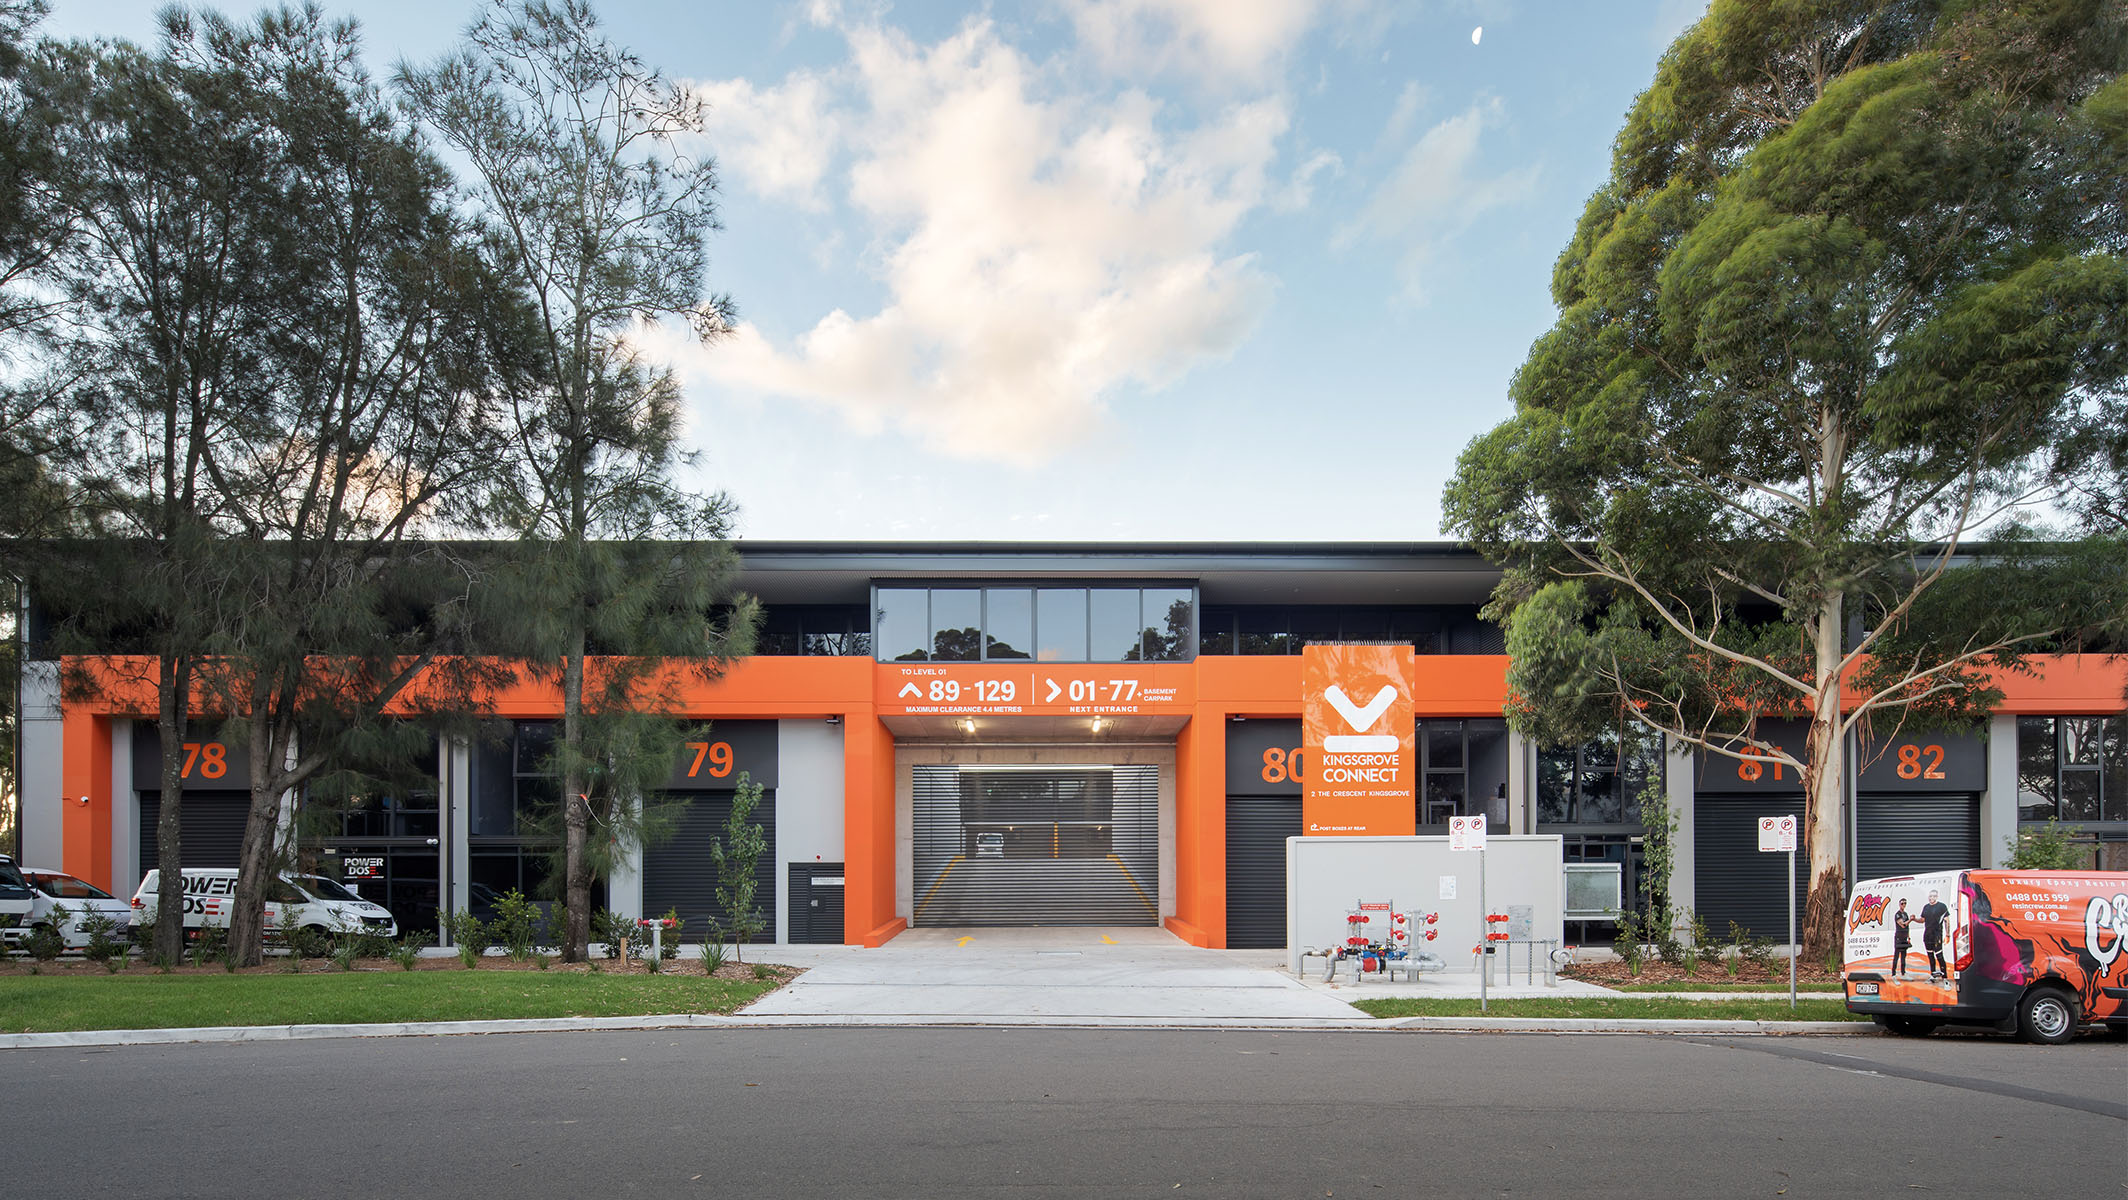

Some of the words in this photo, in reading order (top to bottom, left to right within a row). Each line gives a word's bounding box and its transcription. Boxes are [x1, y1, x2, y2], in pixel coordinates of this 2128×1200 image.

[180, 742, 227, 779] 78
[685, 742, 734, 778] 79
[1262, 747, 1303, 783] 80
[1323, 754, 1400, 766] KINGSGROVE
[1738, 745, 1782, 781] 81
[1897, 744, 1946, 780] 82
[1323, 768, 1399, 782] CONNECT
[344, 858, 384, 867] POWER
[2002, 878, 2041, 887] Luxury
[2047, 878, 2079, 887] Epoxy
[2085, 879, 2115, 887] Resin
[183, 897, 224, 916] OSE.
[2005, 893, 2031, 902] 0488
[2031, 893, 2050, 902] 015
[2052, 893, 2070, 902] 959
